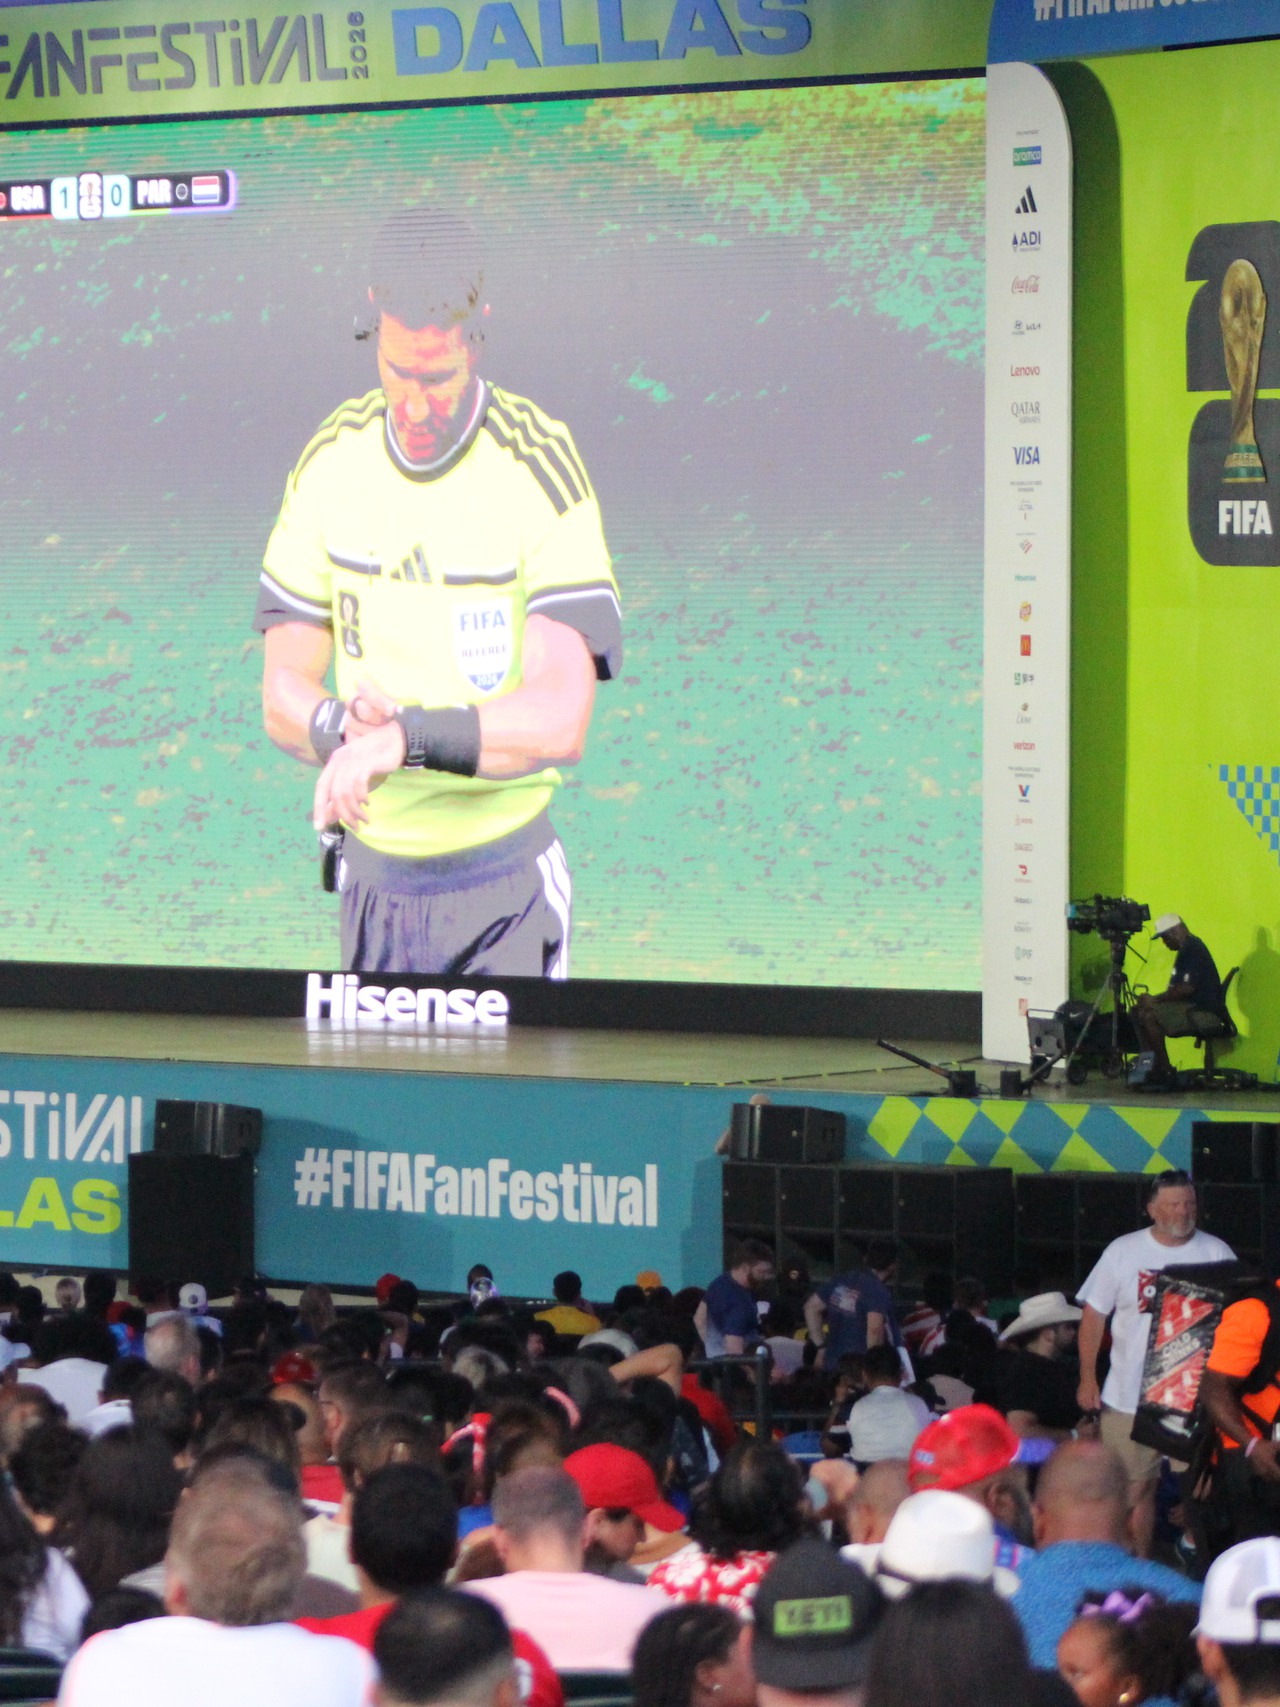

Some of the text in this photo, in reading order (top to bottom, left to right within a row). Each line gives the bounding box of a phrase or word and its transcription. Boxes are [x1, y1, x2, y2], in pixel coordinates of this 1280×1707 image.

[349, 10, 368, 80] 2026
[392, 0, 812, 77] DALLAS
[10, 185, 45, 212] USA
[59, 187, 69, 209] 1
[111, 184, 121, 206] 0
[137, 179, 171, 205] PAR
[1019, 231, 1041, 246] ADI
[1010, 365, 1040, 376] Lenovo
[1011, 401, 1040, 417] QATAR
[1012, 446, 1040, 465] VISA
[1218, 500, 1273, 535] FIFA
[460, 609, 506, 631] FIFA
[306, 973, 509, 1025] Hisense
[294, 1146, 658, 1227] #FIFAFanFestival
